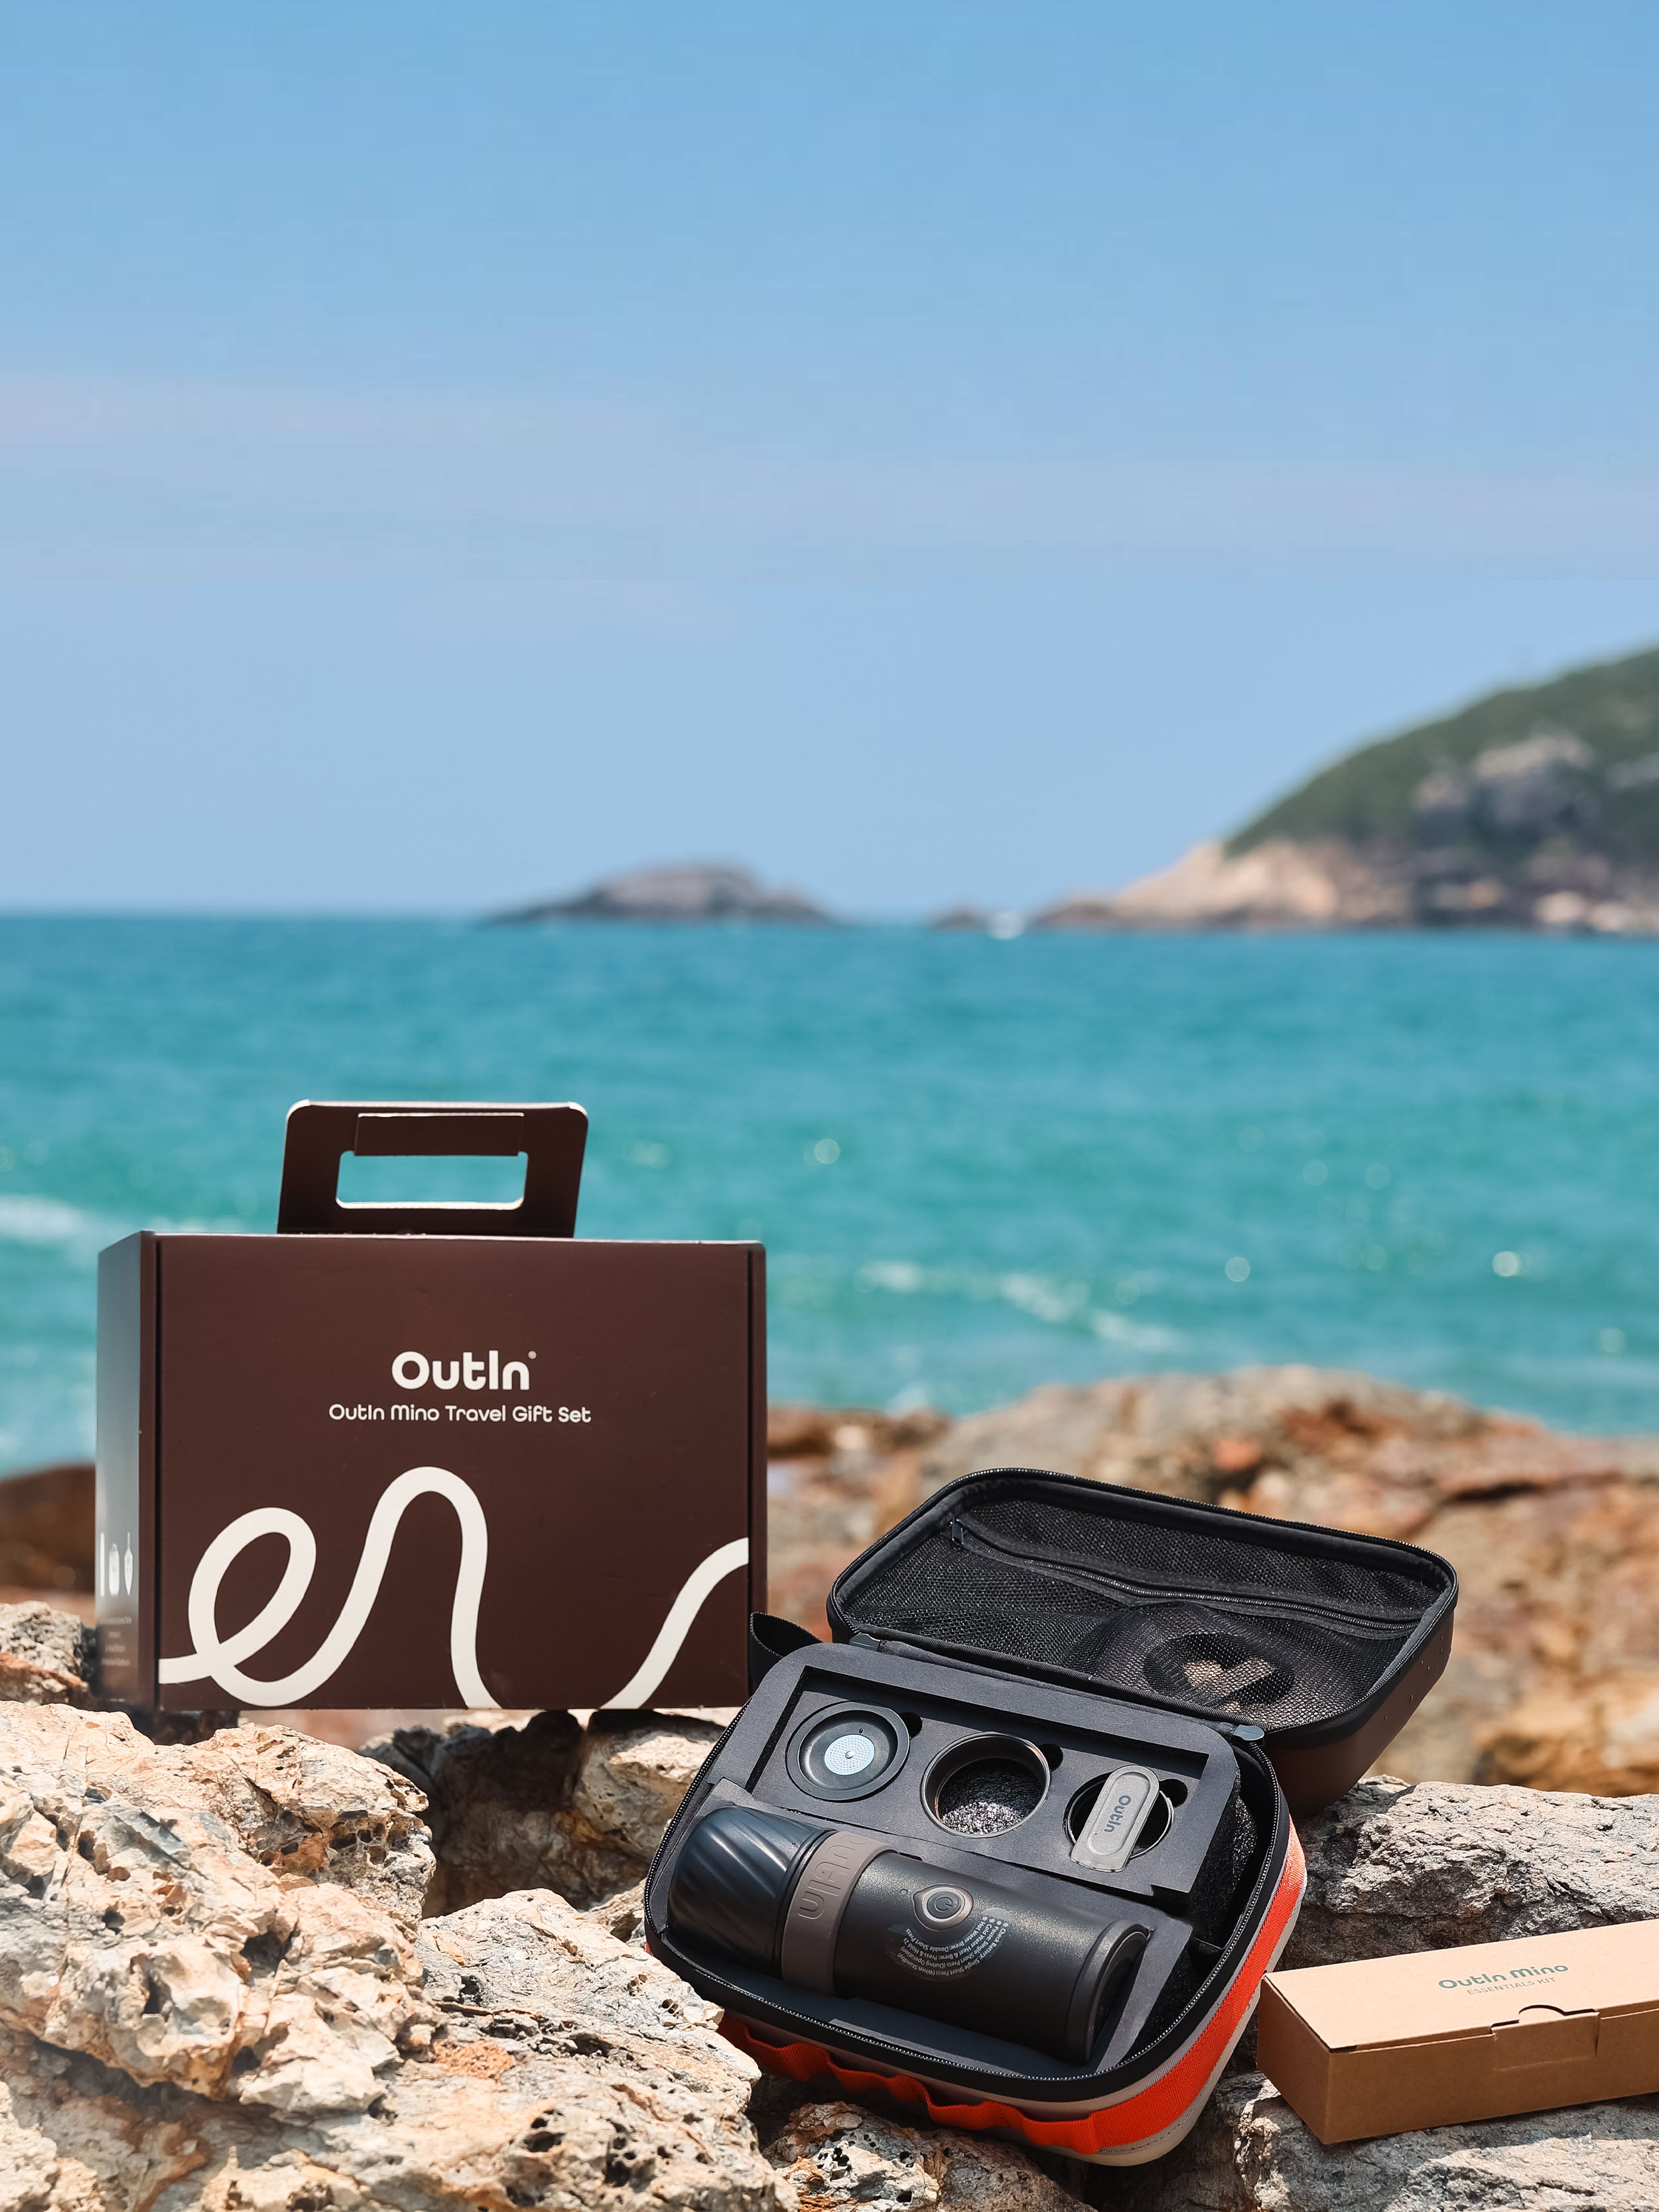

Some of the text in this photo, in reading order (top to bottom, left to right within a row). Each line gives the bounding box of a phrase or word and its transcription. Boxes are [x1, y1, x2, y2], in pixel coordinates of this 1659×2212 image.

[329, 1403, 592, 1423] OutIn Mino Travel Gift Set
[976, 1921, 986, 1931] Hot
[982, 1924, 992, 1935] Cold
[905, 1928, 916, 1942] Press
[964, 1930, 979, 1943] Water
[986, 1926, 1000, 1942] Pause:
[994, 1928, 1006, 1943] Check
[915, 1939, 929, 1951] Short
[949, 1941, 964, 1950] Brew:
[970, 1935, 985, 1948] Water
[974, 1941, 988, 1955] Single
[907, 1943, 919, 1954] Hold
[959, 1946, 972, 1956] Heat
[978, 1942, 997, 1960] Battery:
[900, 1946, 925, 1965] Operation)
[961, 1953, 974, 1964] Short
[926, 1960, 946, 1969] (During
[964, 1958, 980, 1970] Single
[1510, 1965, 1569, 1979] Mino
[1467, 1980, 1535, 1994] ESSENTIALS
